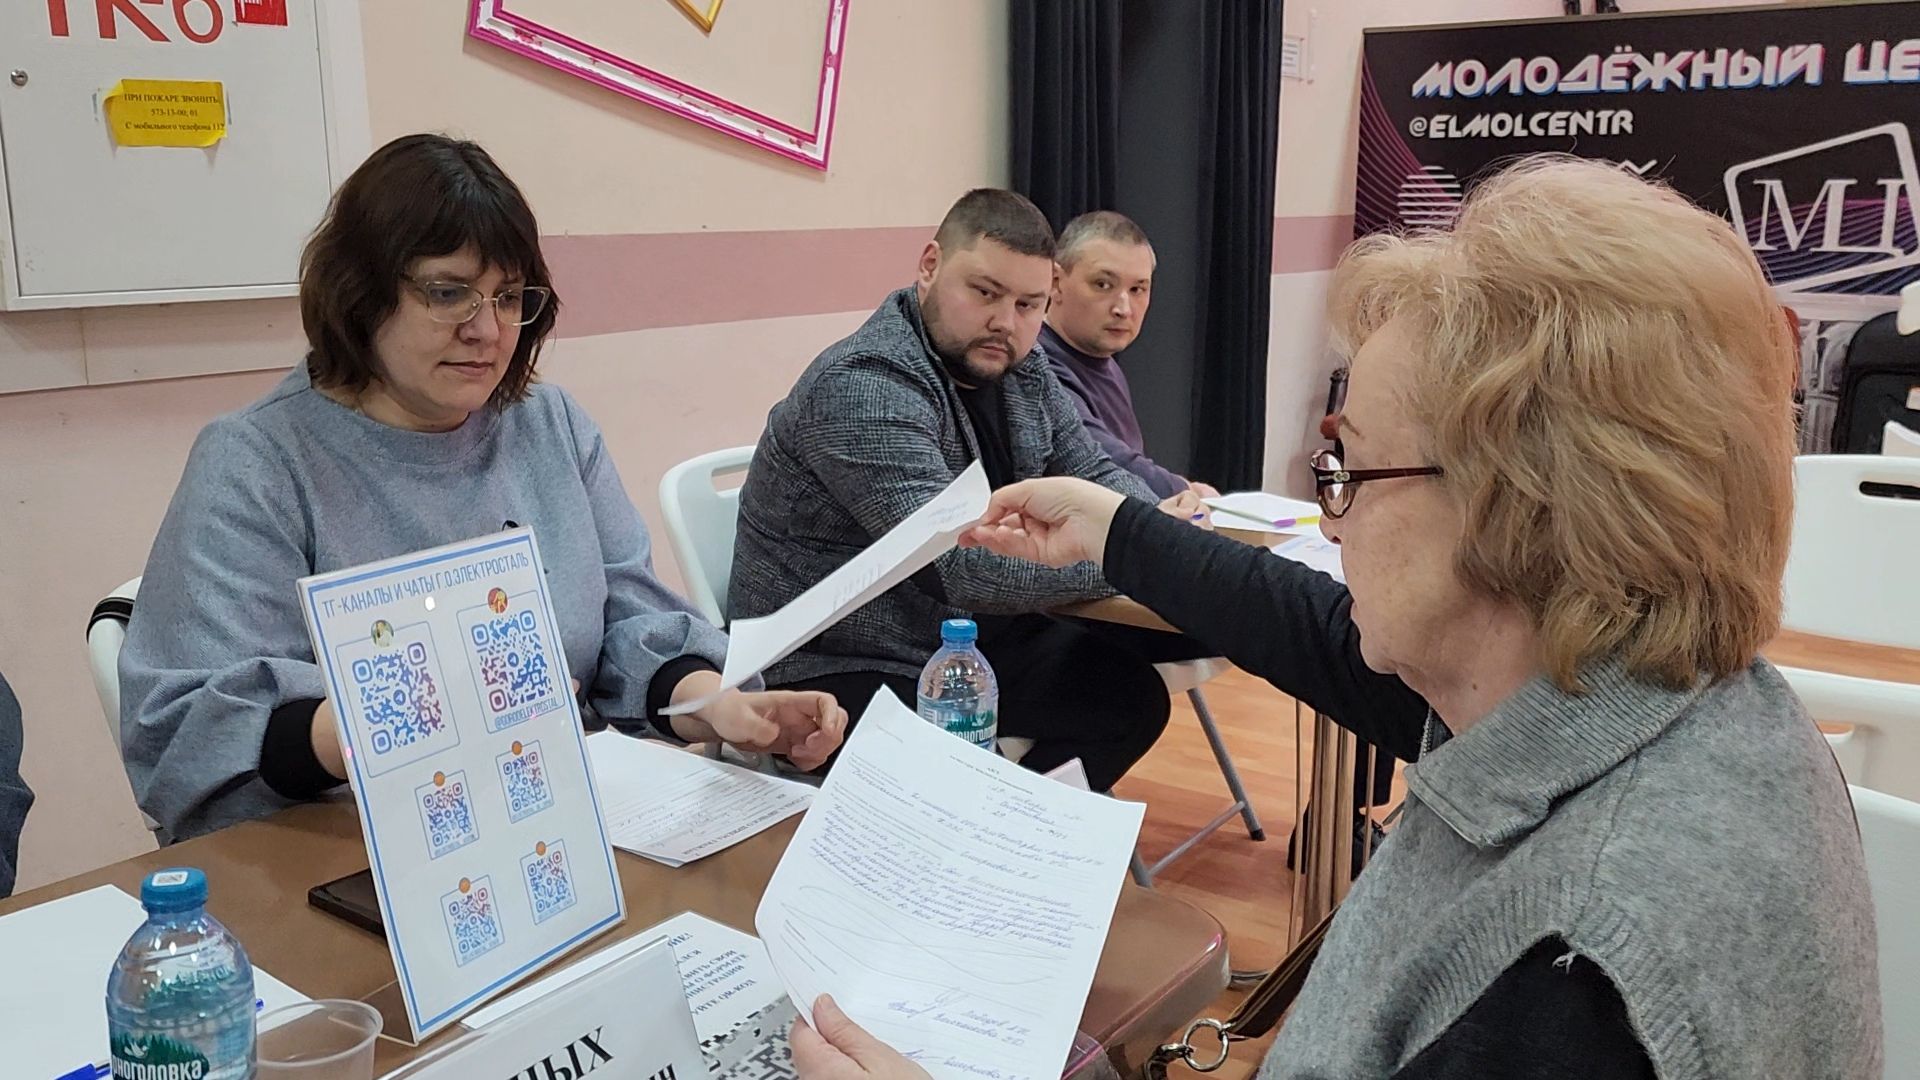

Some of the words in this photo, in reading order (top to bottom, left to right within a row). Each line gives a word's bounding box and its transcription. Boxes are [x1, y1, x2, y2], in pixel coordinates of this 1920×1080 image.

[1411, 43, 1823, 98] МОЛОДЁЖНЫЙ
[124, 93, 142, 102] ПРИ
[144, 94, 179, 103] ПОЖАРЕ
[133, 122, 177, 130] мобильного
[179, 124, 211, 132] телефона
[1409, 109, 1634, 139] @ELMOLCENTR
[394, 584, 405, 600] И
[404, 574, 436, 598] ЧАТЫ
